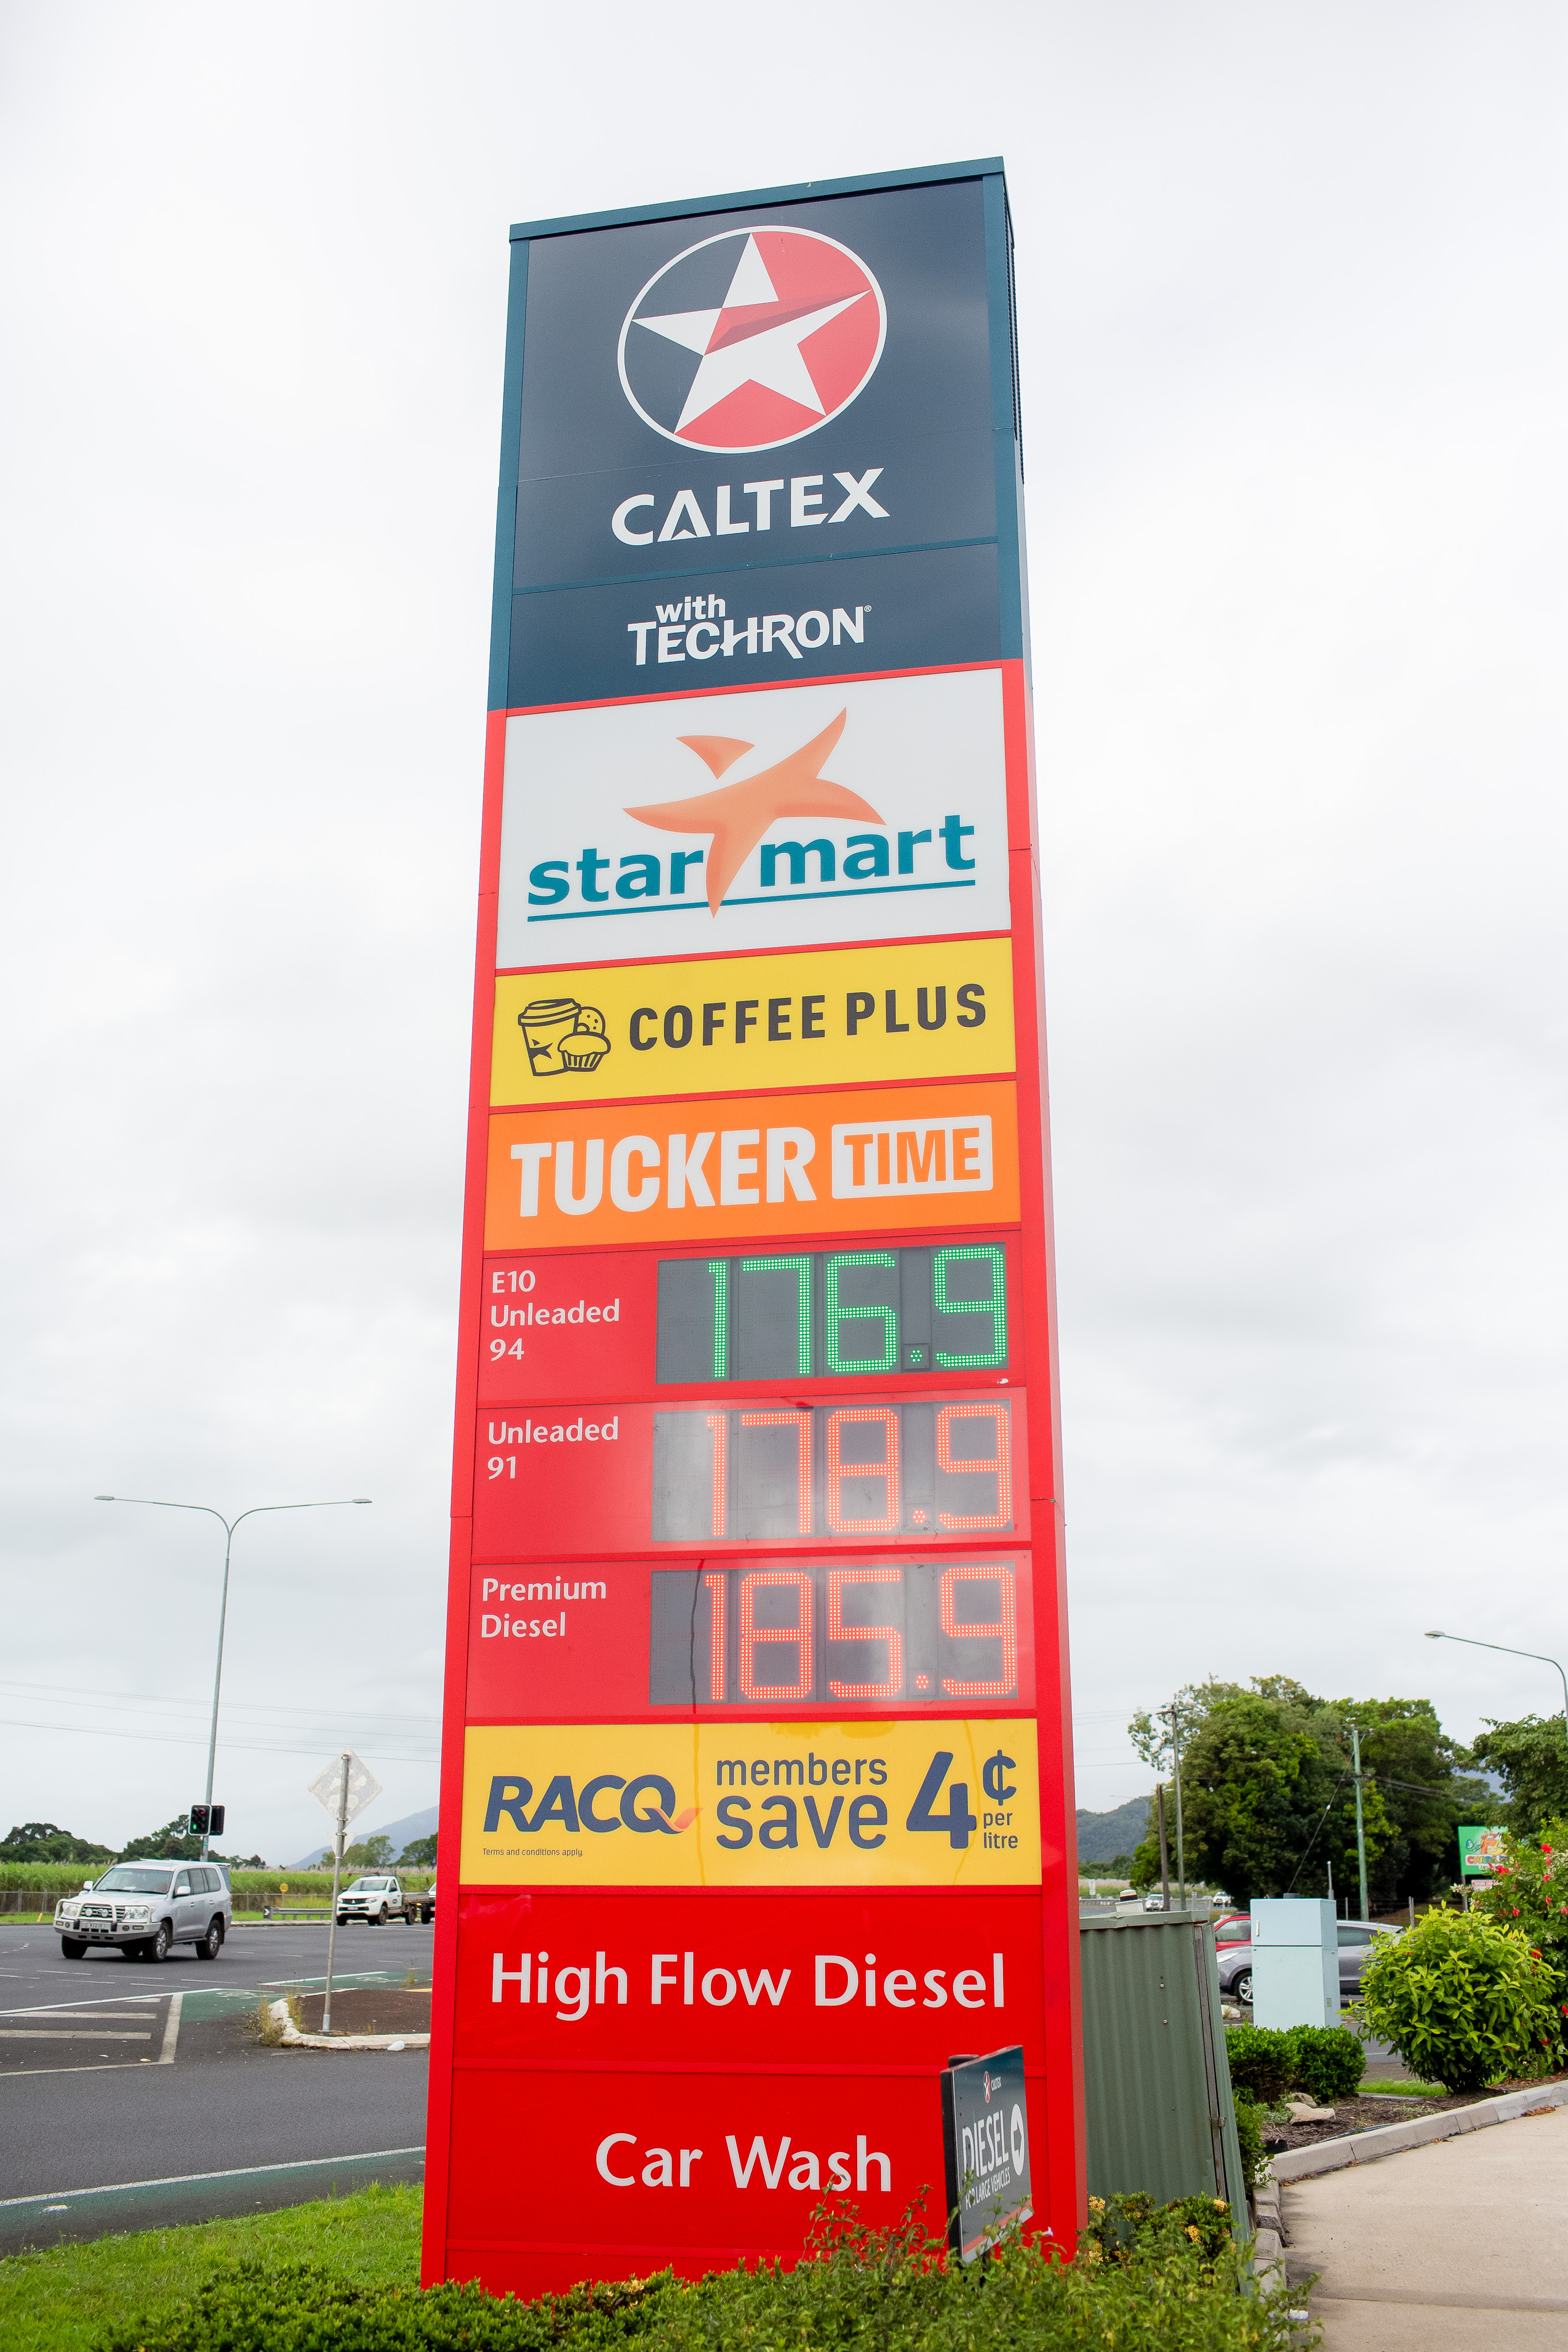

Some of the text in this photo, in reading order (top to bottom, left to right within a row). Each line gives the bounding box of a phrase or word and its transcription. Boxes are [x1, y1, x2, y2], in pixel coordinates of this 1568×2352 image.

[611, 468, 891, 546] CALTEX
[655, 594, 726, 624] with
[527, 814, 976, 906] star mart
[630, 983, 986, 1051] COFFEE PLUS
[510, 1126, 981, 1217] TUCKER TIME
[491, 1269, 536, 1294] E10
[490, 1298, 620, 1328] Unleaded
[707, 1247, 1006, 1378] 176.9
[489, 1337, 525, 1362] 94
[488, 1415, 619, 1445] Unleaded
[487, 1456, 517, 1480] 91
[706, 1404, 1012, 1536] 178.9
[482, 1574, 607, 1601] Premium
[481, 1611, 566, 1638] Diesel
[705, 1566, 1017, 1700] 185.9
[716, 1751, 888, 1786] members
[483, 1774, 677, 1835] RACQ
[716, 1794, 888, 1850] save
[983, 1812, 1013, 1829] per
[562, 1848, 583, 1857] apply.
[983, 1832, 1018, 1849] litre
[492, 1950, 1005, 2021] High Flow Diesel
[991, 2076, 1002, 2091] CALTEX
[595, 2132, 892, 2192] Car Wash
[962, 2109, 1009, 2182] DIESEL
[975, 2178, 991, 2204] LARGE
[990, 2166, 1011, 2194] VEHICLES
